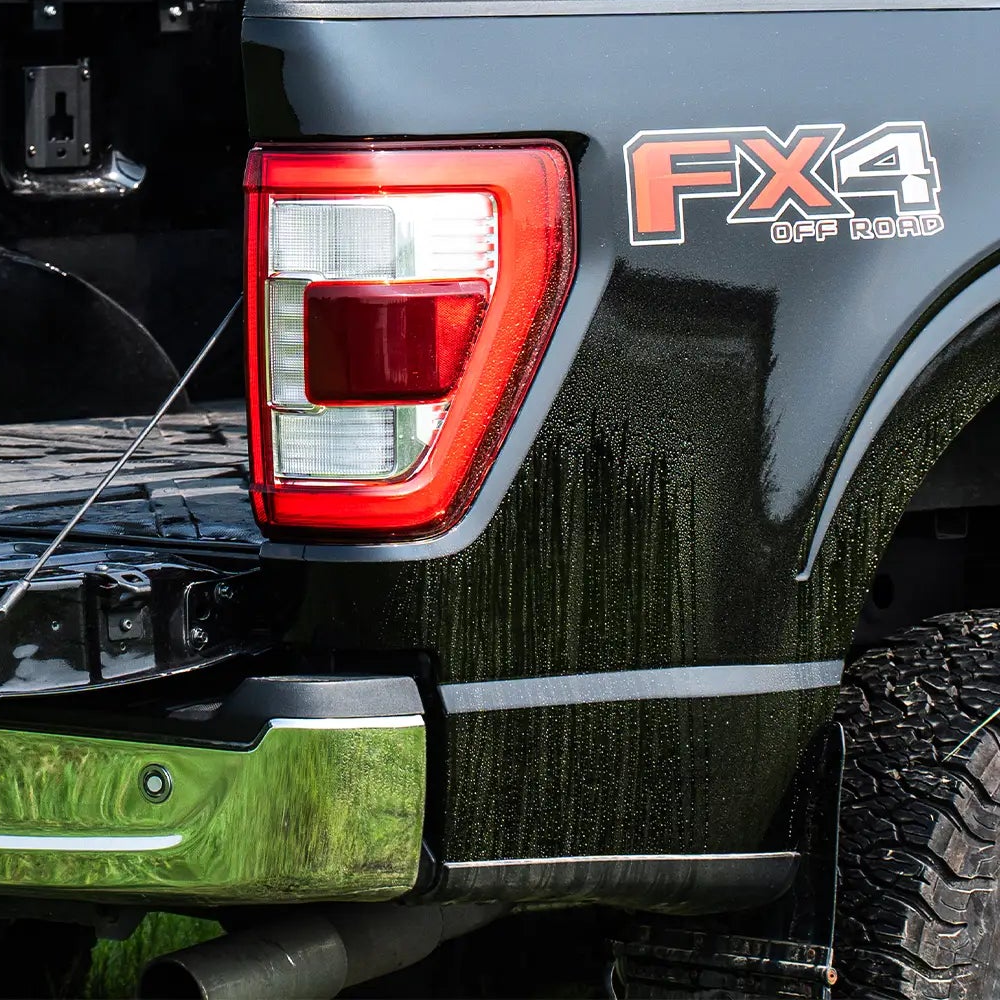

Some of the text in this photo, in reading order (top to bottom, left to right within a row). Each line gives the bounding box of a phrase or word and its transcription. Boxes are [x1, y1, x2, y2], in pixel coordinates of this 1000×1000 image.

[623, 121, 941, 246] FX4
[771, 214, 944, 243] OFF ROAD
